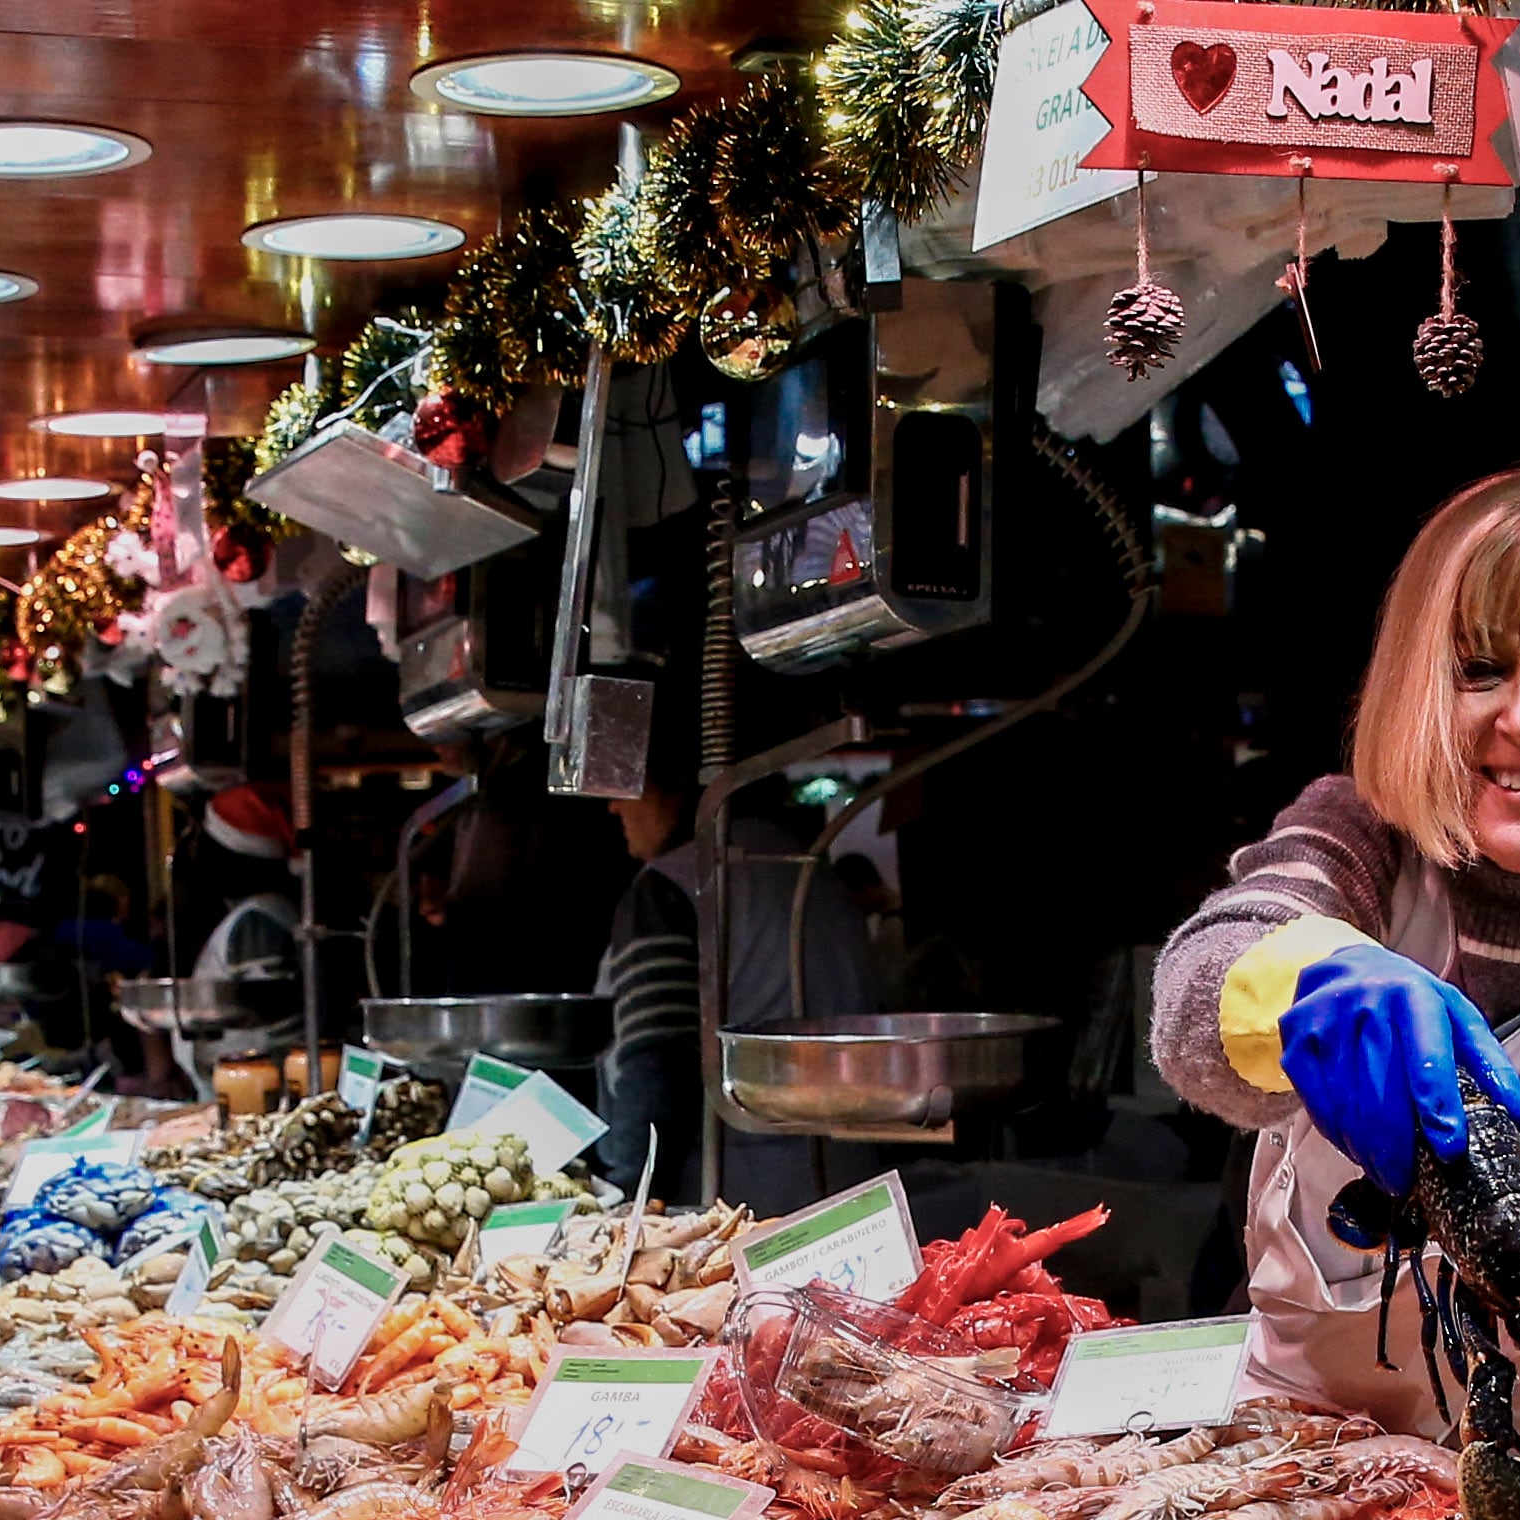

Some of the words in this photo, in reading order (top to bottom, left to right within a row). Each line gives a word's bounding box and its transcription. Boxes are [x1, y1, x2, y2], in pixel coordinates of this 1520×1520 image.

[1266, 48, 1433, 124] Nadal
[764, 1254, 810, 1284] GAMBOT
[818, 1218, 887, 1257] CARABINERO
[590, 1391, 641, 1403] GAMBA
